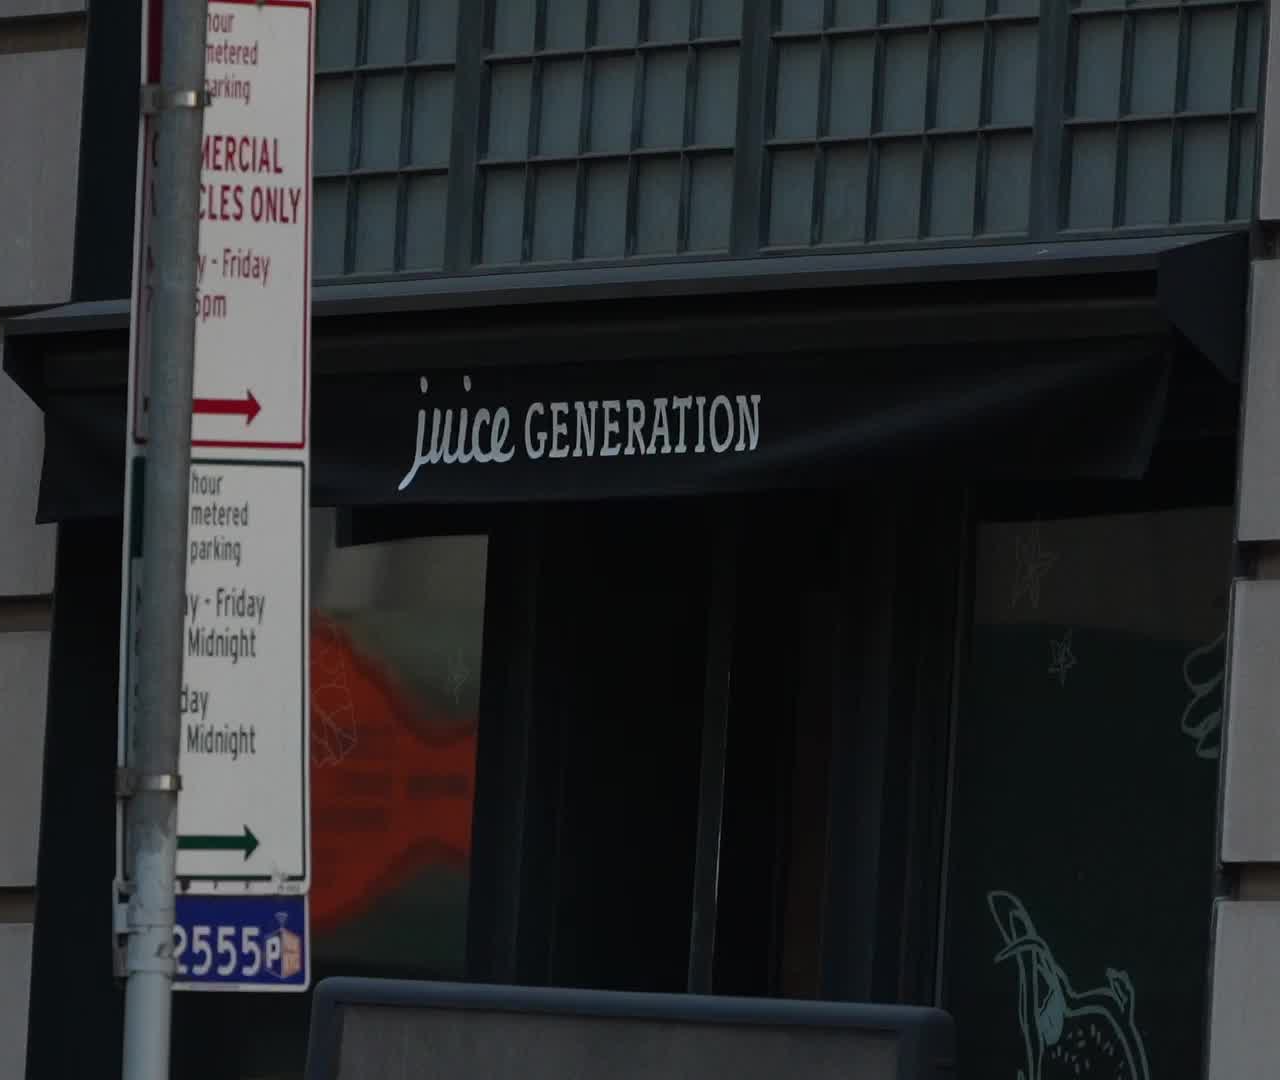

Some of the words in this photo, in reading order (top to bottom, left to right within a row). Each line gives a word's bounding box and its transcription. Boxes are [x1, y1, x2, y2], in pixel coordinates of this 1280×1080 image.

[251, 186, 301, 223] ONLY
[222, 249, 271, 287] Friday
[398, 374, 516, 491] juice
[524, 393, 762, 460] GENERATION
[191, 473, 224, 494] hour
[191, 502, 248, 526] metered
[190, 536, 241, 566] parking
[216, 588, 265, 624] Friday
[188, 626, 256, 664] Midnight
[187, 723, 256, 760] Midnight
